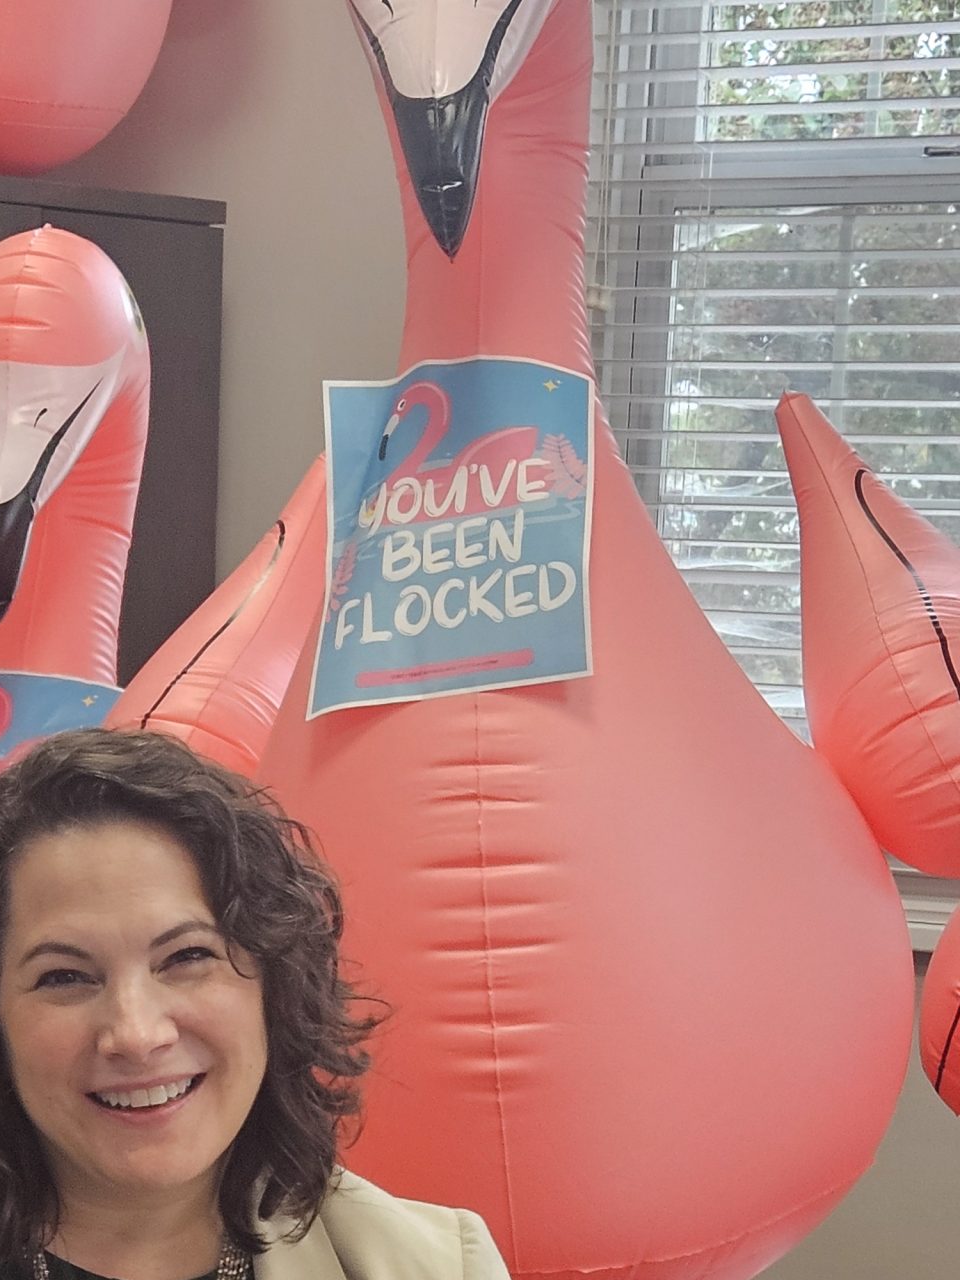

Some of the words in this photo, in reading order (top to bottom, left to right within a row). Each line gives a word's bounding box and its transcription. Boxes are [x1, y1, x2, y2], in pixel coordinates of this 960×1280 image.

[358, 458, 552, 537] YOU'VE
[381, 508, 525, 583] BEEN
[334, 561, 577, 650] FLOCKED
